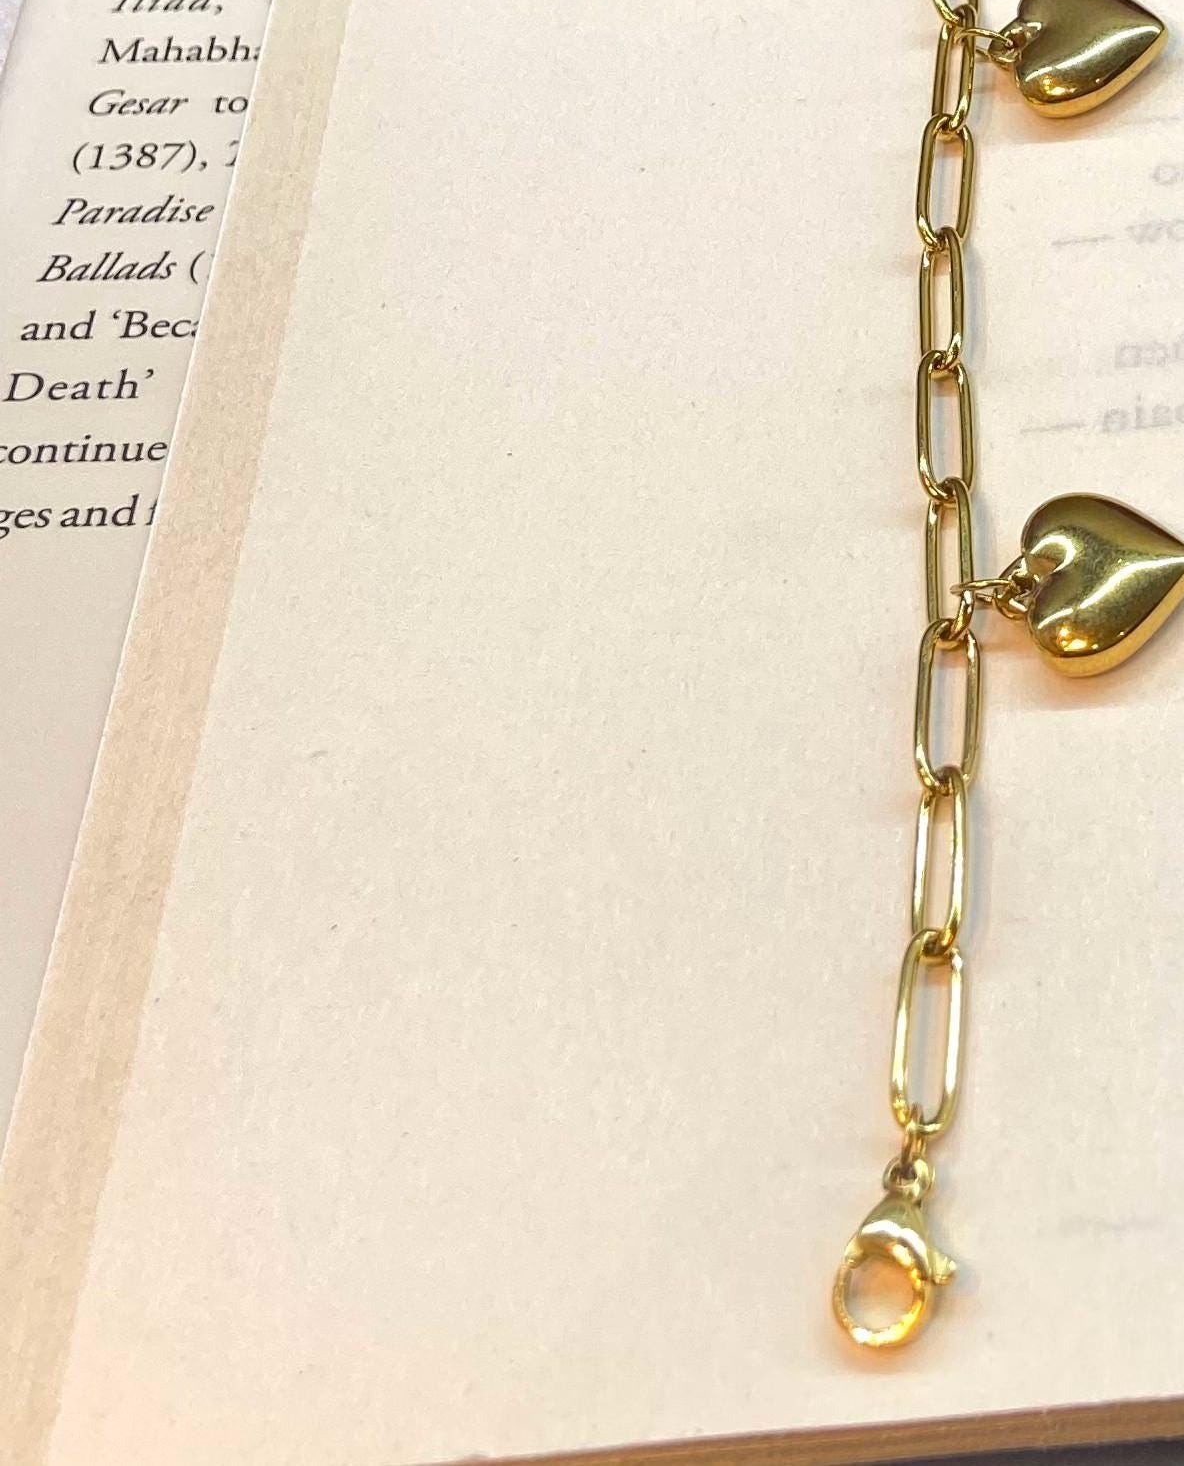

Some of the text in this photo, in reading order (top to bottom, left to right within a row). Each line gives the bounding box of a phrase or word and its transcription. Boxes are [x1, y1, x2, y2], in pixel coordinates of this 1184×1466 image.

[89, 89, 249, 117] Gesar to
[71, 140, 209, 175] (1387),
[52, 195, 215, 226] Paradise
[36, 250, 178, 283] Ballads
[20, 309, 97, 342] and
[2, 368, 155, 403] Death’
[60, 493, 140, 527] and
